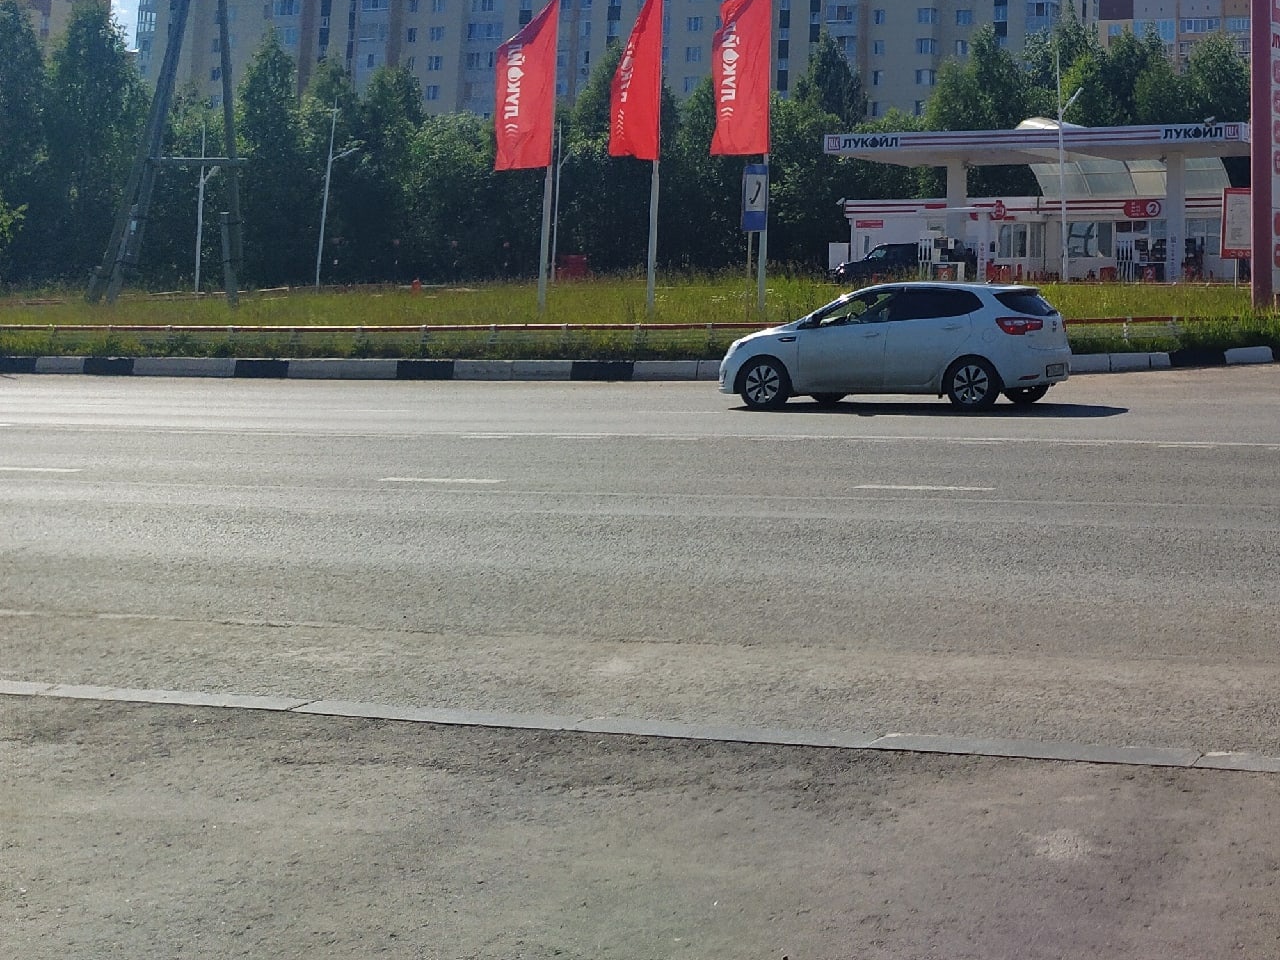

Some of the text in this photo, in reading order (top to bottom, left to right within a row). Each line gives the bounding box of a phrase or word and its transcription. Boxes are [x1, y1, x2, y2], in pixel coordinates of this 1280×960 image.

[1163, 126, 1223, 139] ЛУКОЙЛ
[842, 135, 899, 149] ЛУКОЙЛ
[1148, 203, 1157, 214] 2
